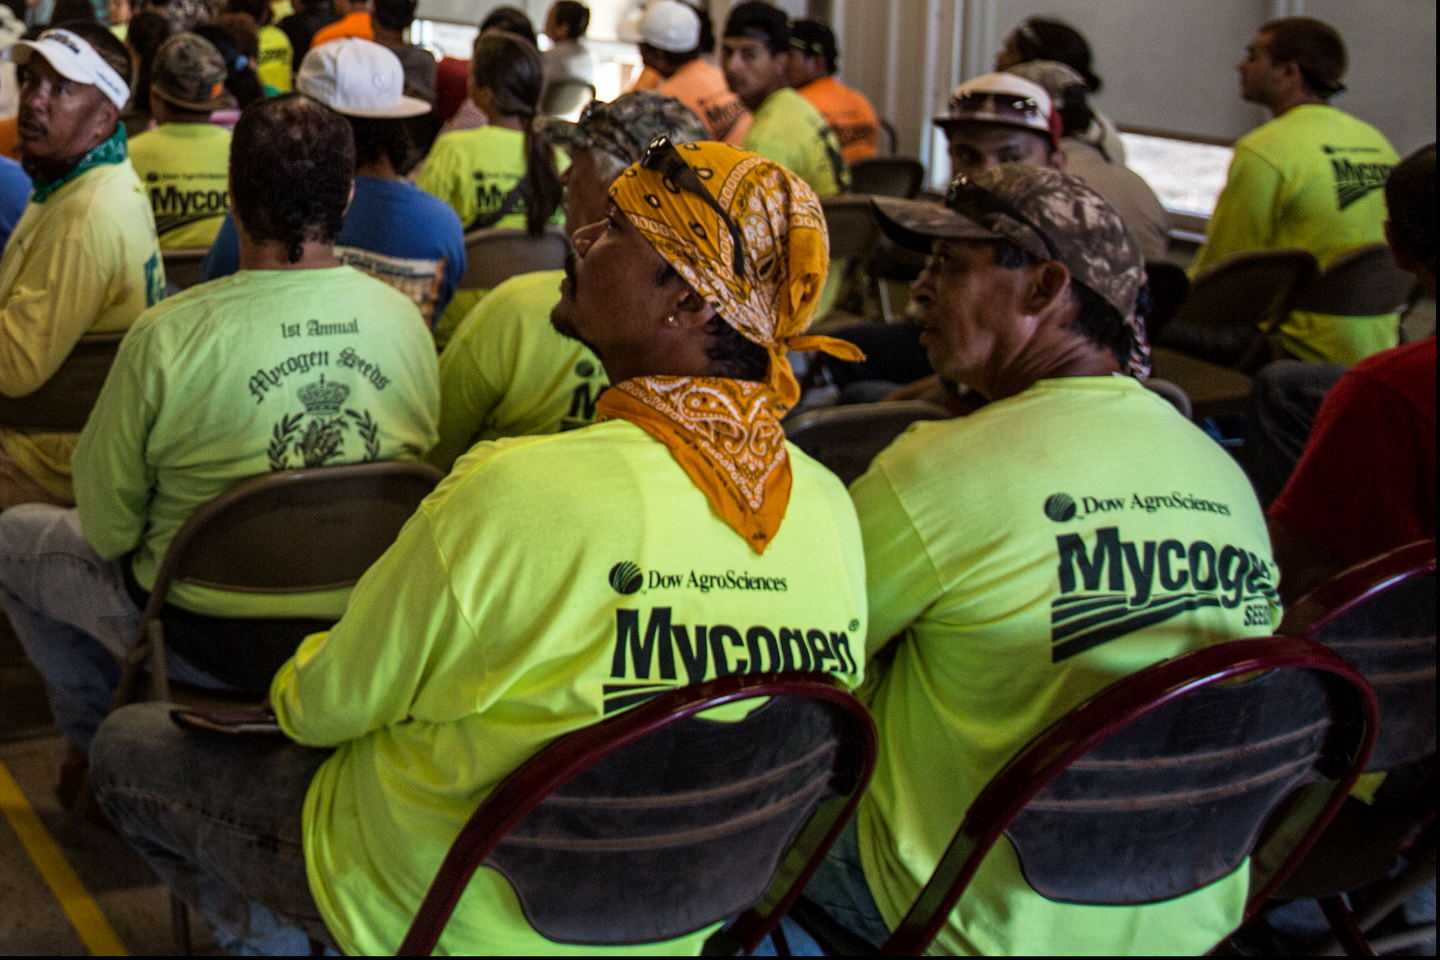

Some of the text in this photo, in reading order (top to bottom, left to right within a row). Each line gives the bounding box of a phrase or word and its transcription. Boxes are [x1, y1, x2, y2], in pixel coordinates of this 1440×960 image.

[151, 185, 230, 216] Myco
[306, 318, 360, 337] Annual
[248, 346, 391, 404] Mycogen Seeds
[1080, 492, 1232, 517] Dow AgroSciences
[1056, 526, 1277, 609] Mycoge
[647, 569, 788, 592] Dow AgroSciences
[1244, 604, 1272, 627] SEED
